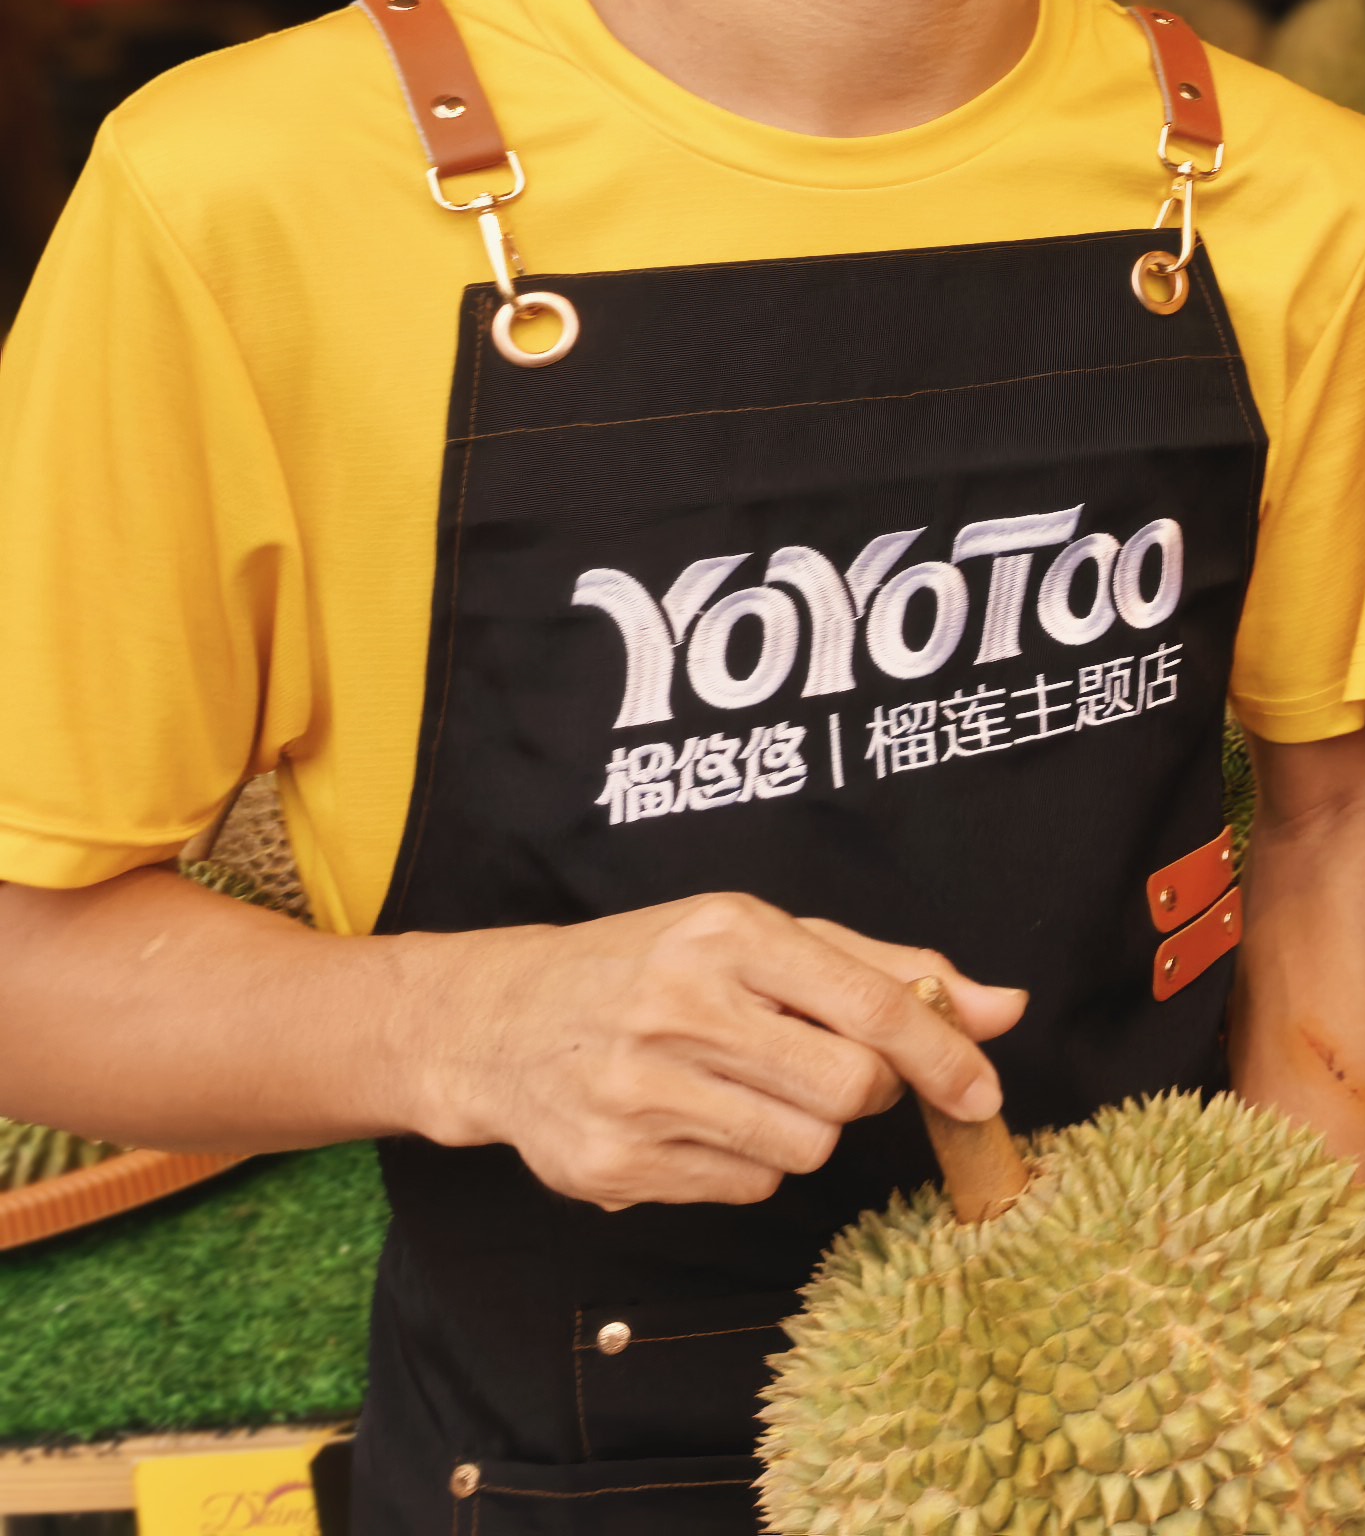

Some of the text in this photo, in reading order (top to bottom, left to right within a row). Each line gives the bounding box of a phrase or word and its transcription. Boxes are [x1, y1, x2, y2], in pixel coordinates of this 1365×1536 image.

[594, 643, 1184, 825] 榴悠悠 榴莲主题店
